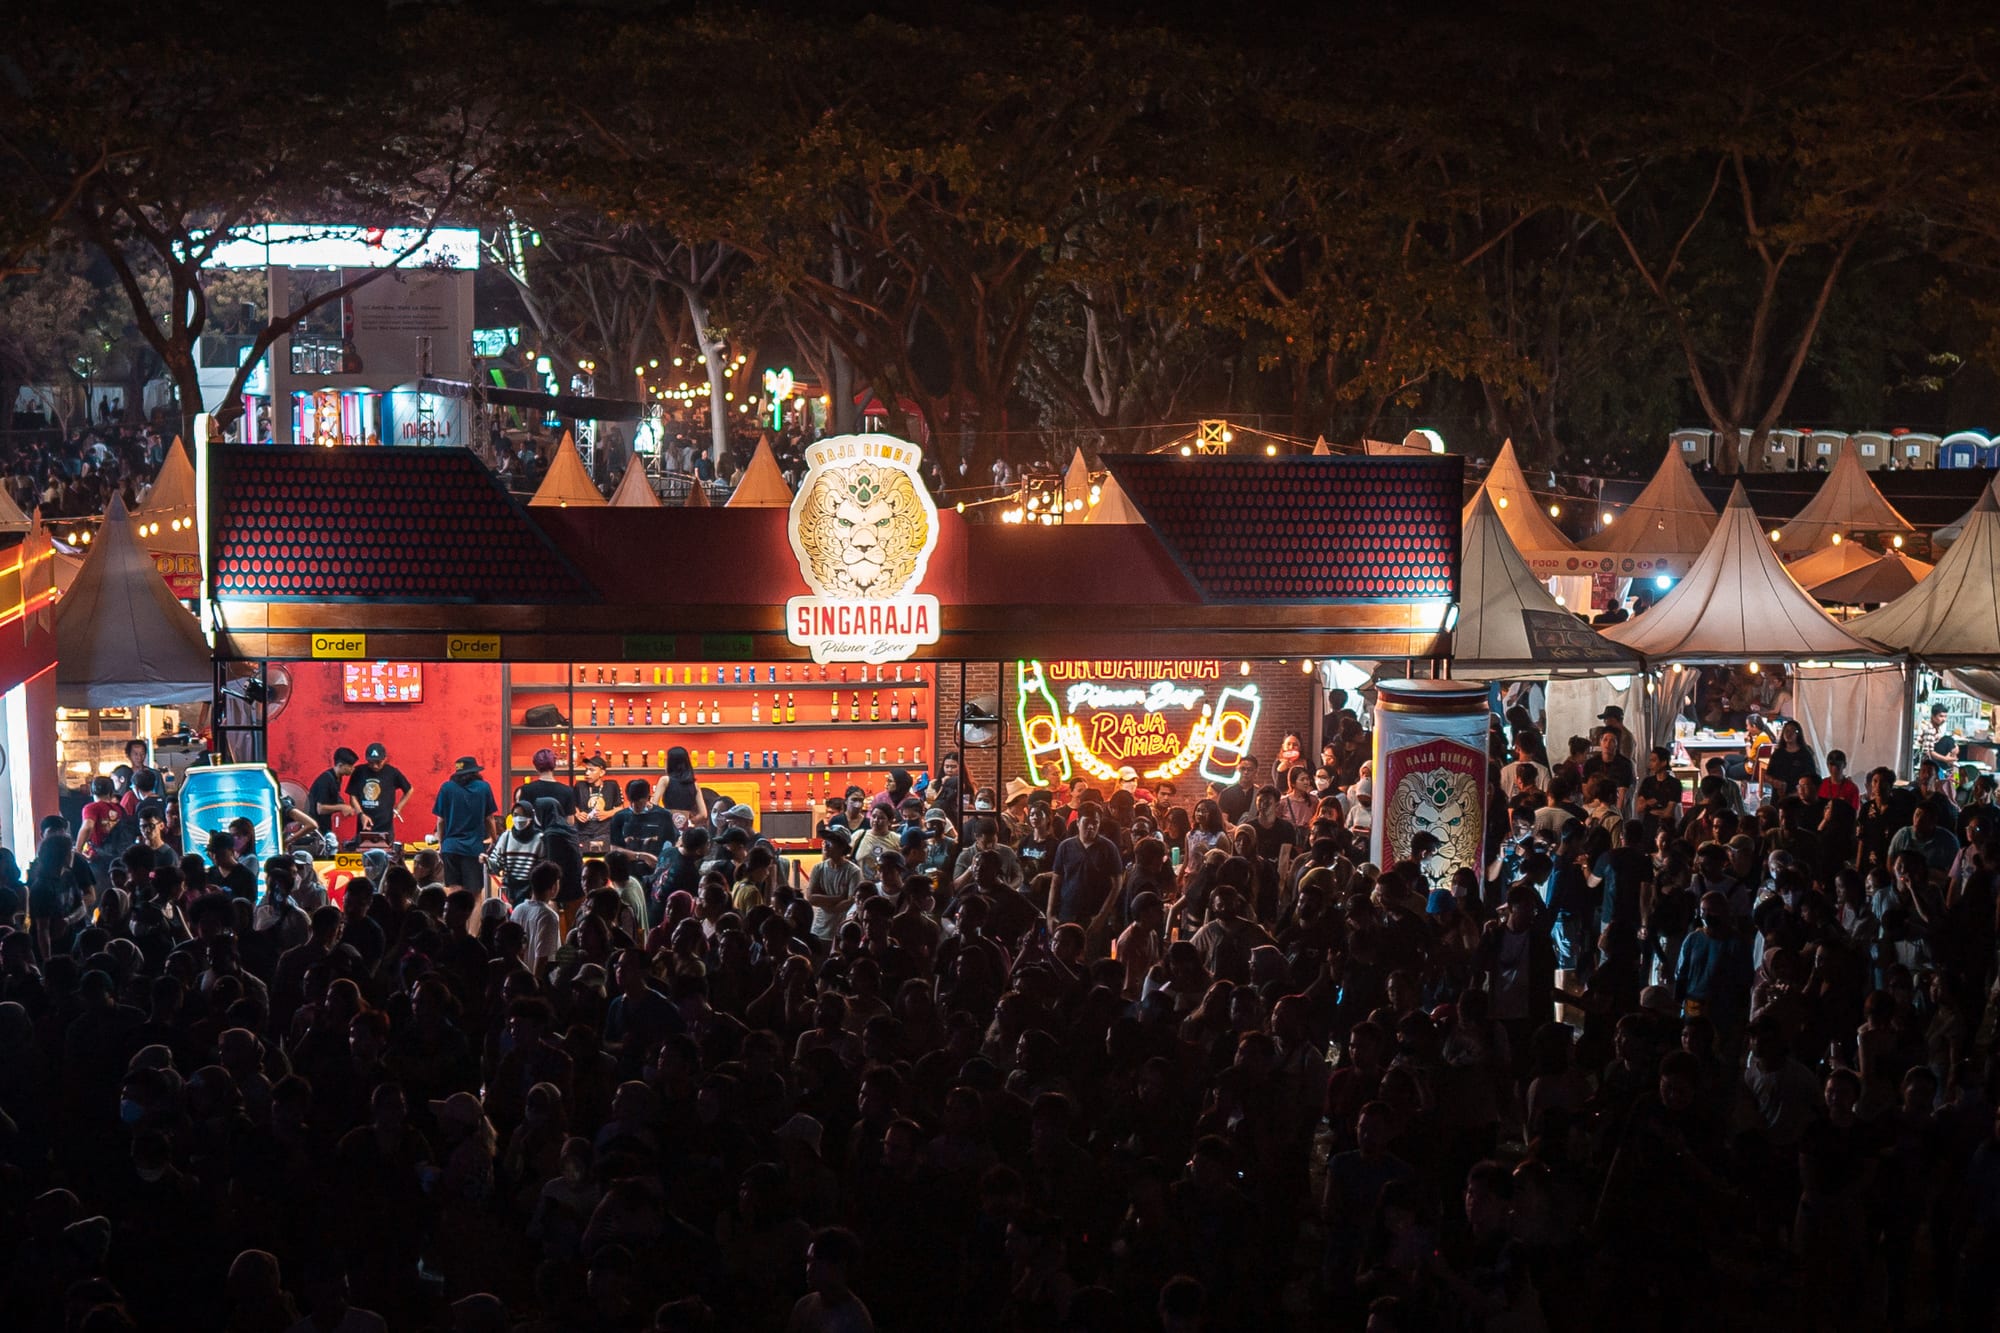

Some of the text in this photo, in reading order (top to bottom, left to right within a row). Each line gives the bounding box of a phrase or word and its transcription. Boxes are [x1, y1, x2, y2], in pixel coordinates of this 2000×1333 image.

[815, 443, 913, 465] RAJA RIMBA
[1532, 559, 1559, 568] FOOD
[798, 605, 929, 635] SINGARAJA
[315, 638, 362, 651] Order
[450, 639, 497, 652] Order
[820, 639, 907, 656] Pilsner Beer
[1406, 752, 1473, 769] RAJA RIMBA
